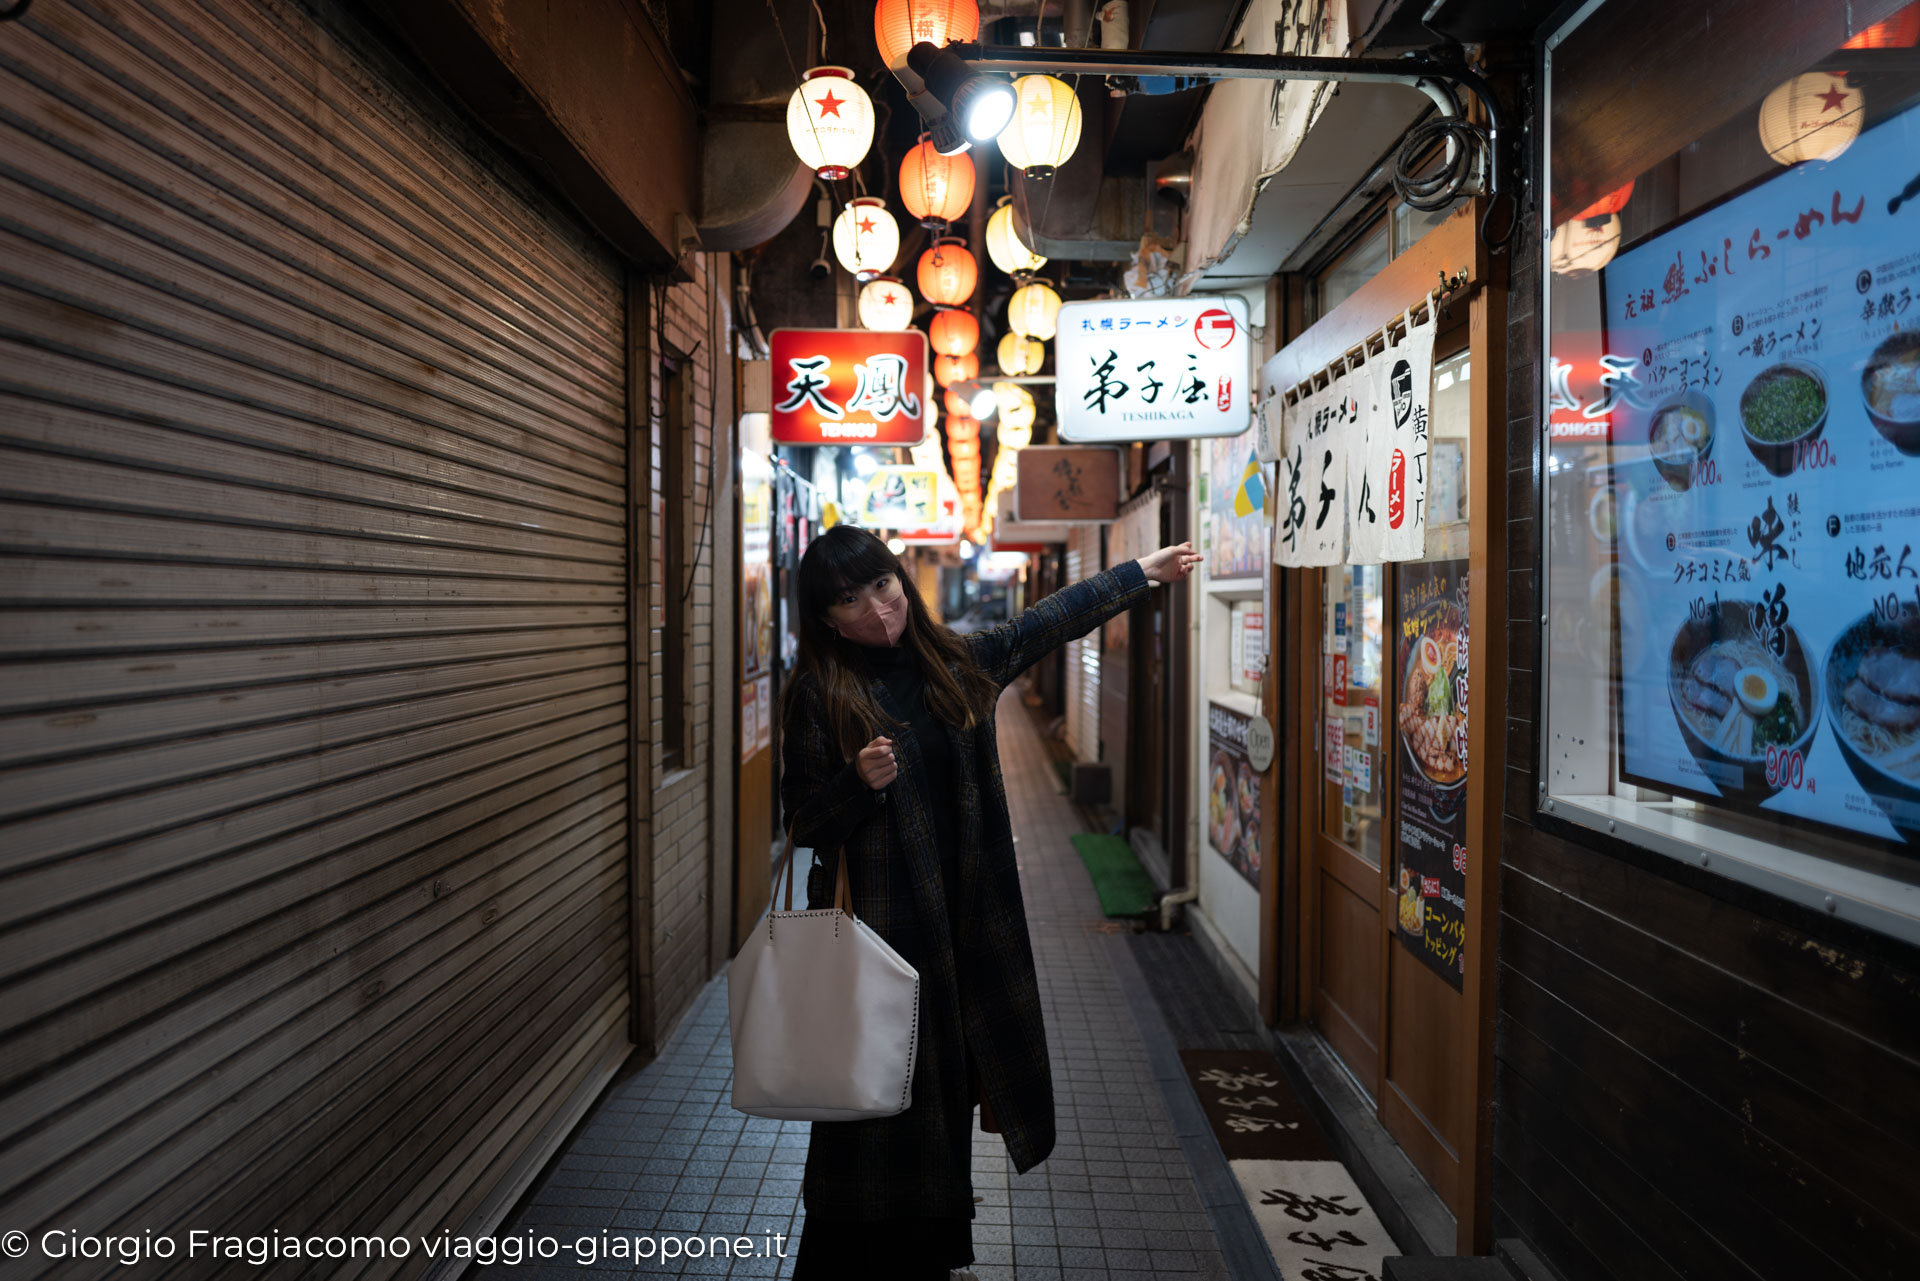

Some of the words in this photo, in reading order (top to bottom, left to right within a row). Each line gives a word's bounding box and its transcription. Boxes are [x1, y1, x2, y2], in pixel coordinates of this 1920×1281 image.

[1624, 294, 1655, 320] 元祖
[1082, 316, 1189, 332] 札幌ラーメン
[1084, 349, 1209, 414] 弟子屈
[1648, 350, 1712, 384] バターコーン
[1679, 366, 1723, 397] ラーメン
[775, 354, 920, 422] 天鳳
[1122, 411, 1195, 422] TESHIKAGA
[1389, 451, 1401, 522] ラーメン
[1674, 558, 1751, 584] クチコミ人気
[1689, 590, 1722, 621] NO.1
[1425, 928, 1458, 967] トッピング
